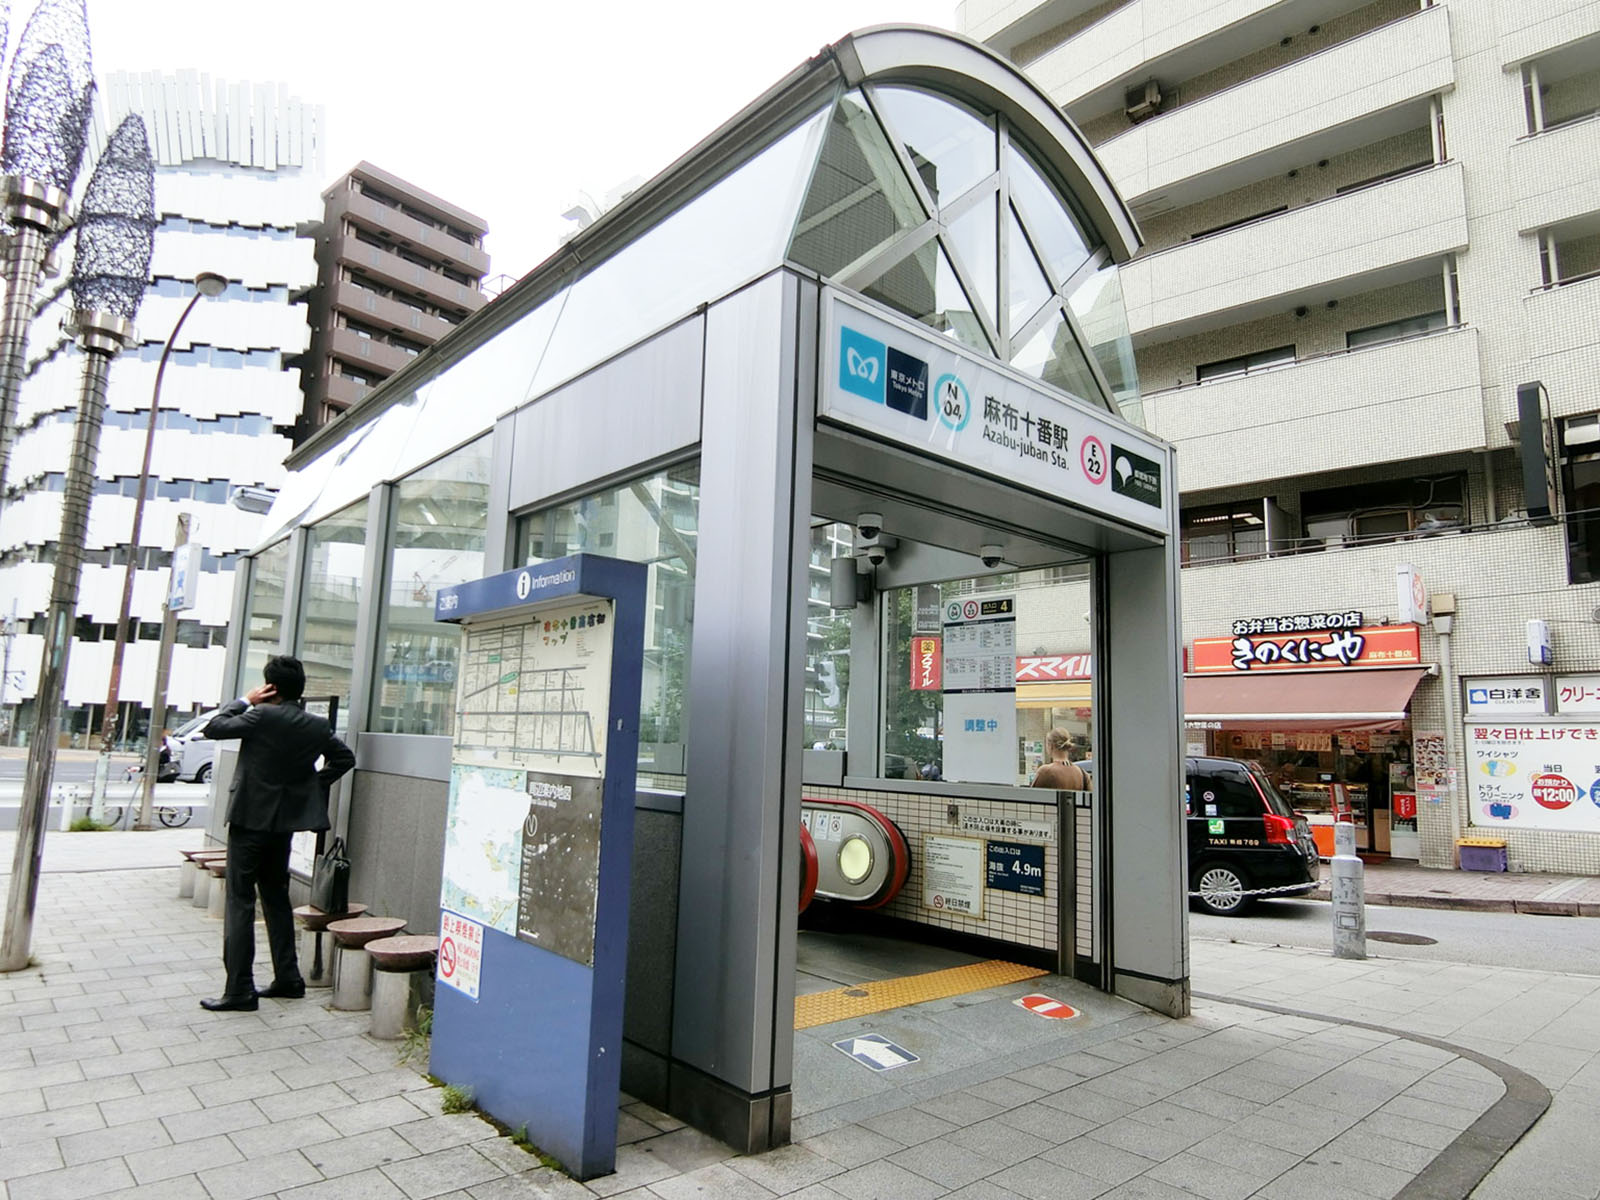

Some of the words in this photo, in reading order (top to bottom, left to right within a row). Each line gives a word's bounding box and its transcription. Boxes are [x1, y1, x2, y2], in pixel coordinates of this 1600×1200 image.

[890, 369, 925, 391] 東京メトロ
[947, 382, 958, 400] N
[943, 400, 962, 420] 04
[983, 395, 1069, 452] 麻布十番駅
[982, 424, 1049, 463] Azabu-juban
[1051, 450, 1070, 471] Sta.
[1091, 444, 1097, 457] E
[1087, 457, 1101, 476] 22
[531, 570, 576, 591] Information
[1000, 600, 1009, 612] 4
[1233, 612, 1361, 636] お弁当お惣菜の店
[1231, 630, 1363, 670] きのくにや
[963, 718, 998, 732] 調整中
[1474, 728, 1598, 740] 翌々日仕上げでき
[1476, 750, 1519, 759] ワイシャツ
[1543, 764, 1563, 773] 当日
[1479, 791, 1524, 800] クリーニング
[988, 845, 1021, 856] この出入口は
[1208, 838, 1228, 846] TAXI
[988, 860, 1005, 872] 海抜
[1011, 859, 1042, 877] 4.9m
